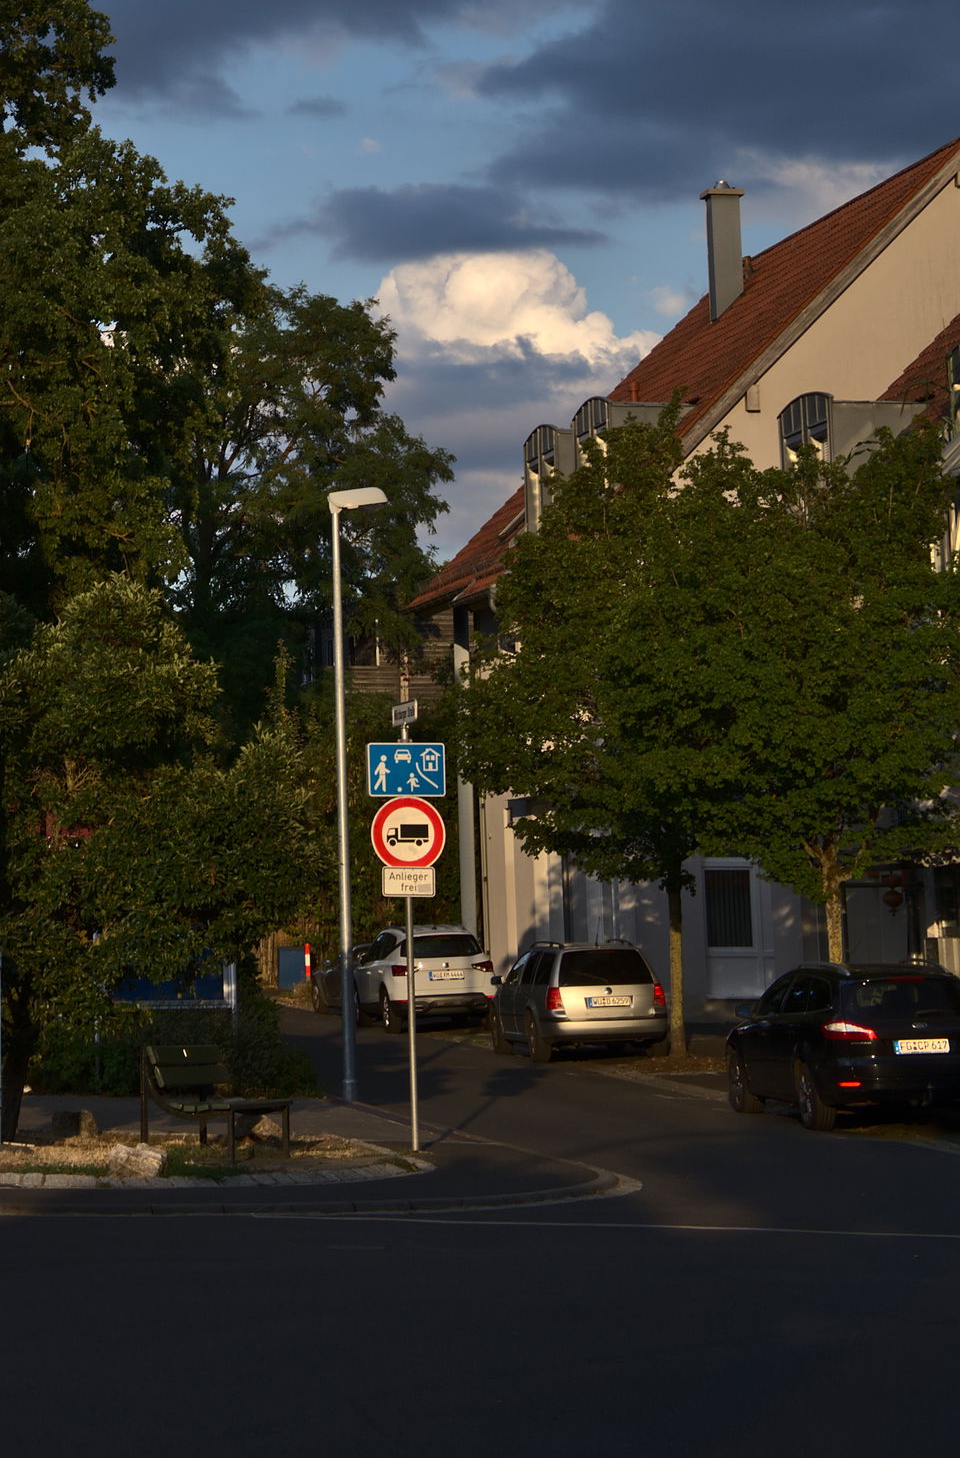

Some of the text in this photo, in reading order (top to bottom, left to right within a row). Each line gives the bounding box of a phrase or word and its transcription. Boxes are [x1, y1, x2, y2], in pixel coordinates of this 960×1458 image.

[389, 871, 428, 882] Anlieger
[401, 883, 417, 892] frei
[931, 1041, 947, 1050] 617
